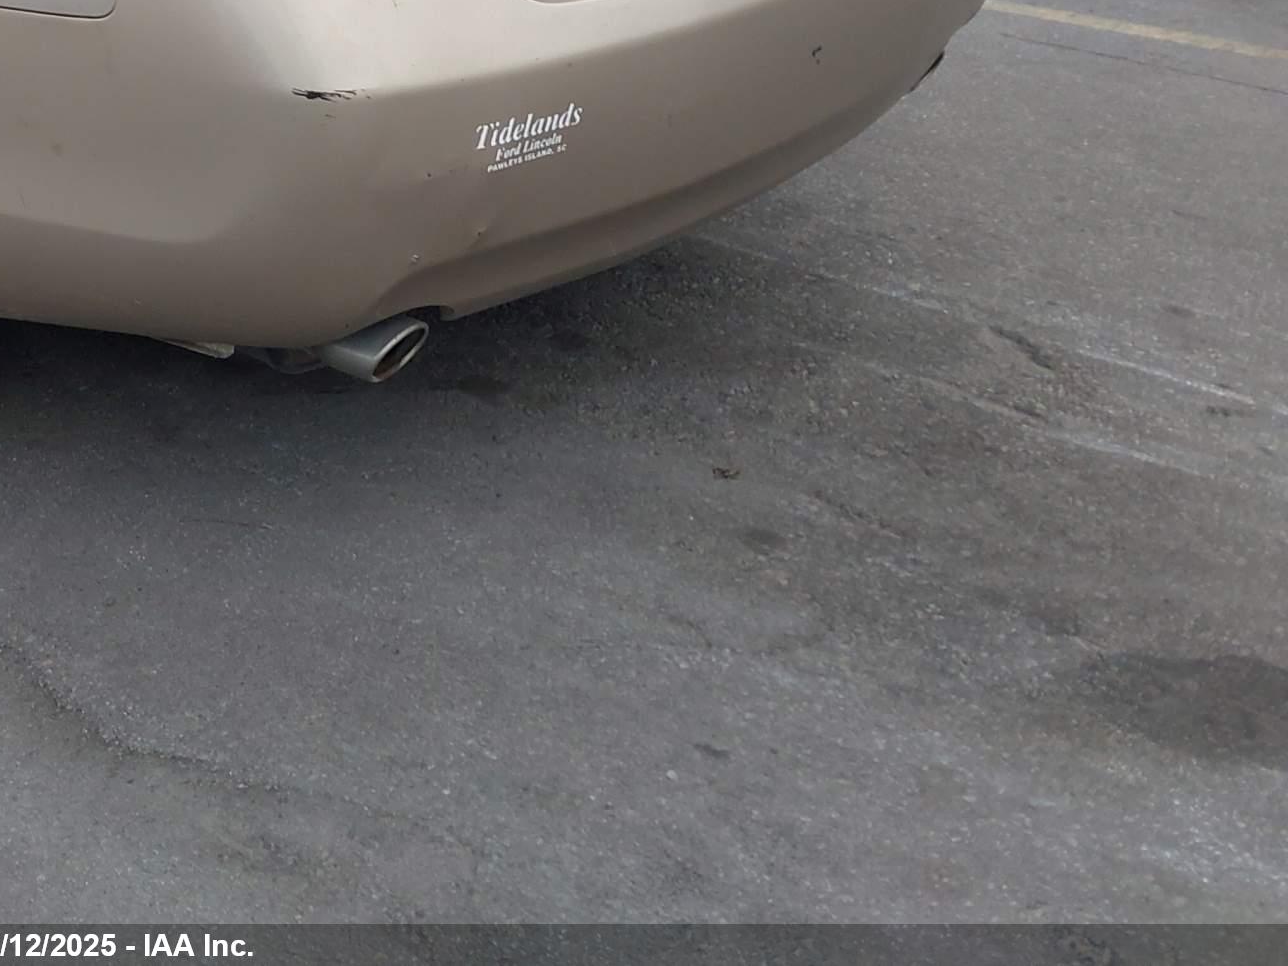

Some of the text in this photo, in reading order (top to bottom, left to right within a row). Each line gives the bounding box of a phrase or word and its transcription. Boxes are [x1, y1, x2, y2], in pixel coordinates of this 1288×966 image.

[476, 103, 583, 149] Tidelands
[495, 132, 563, 162] Ford Lincoln
[487, 156, 523, 173] PAWLEYS
